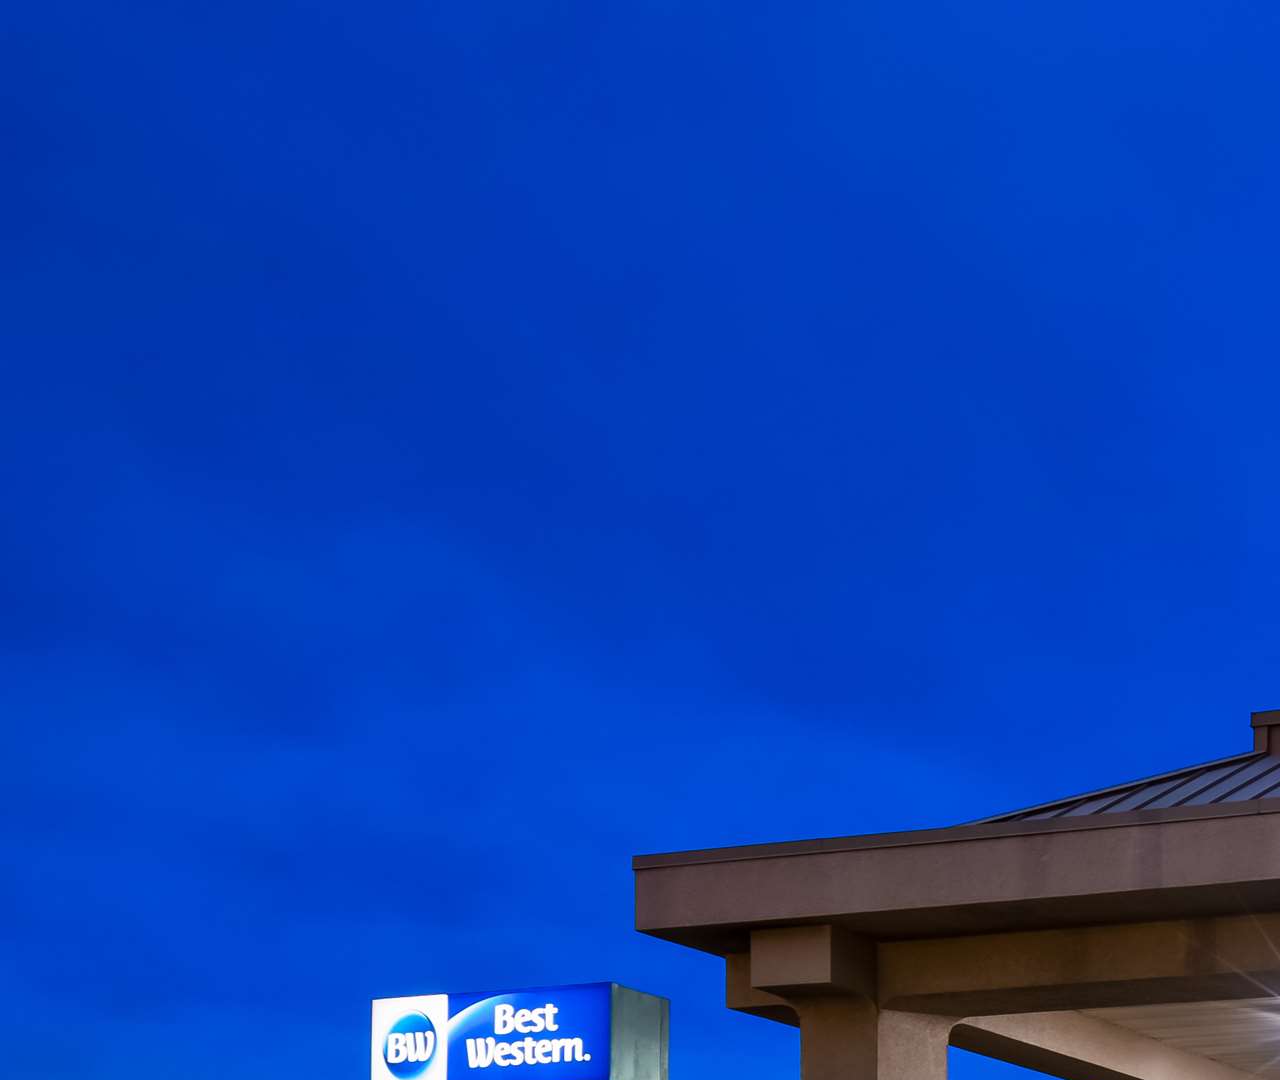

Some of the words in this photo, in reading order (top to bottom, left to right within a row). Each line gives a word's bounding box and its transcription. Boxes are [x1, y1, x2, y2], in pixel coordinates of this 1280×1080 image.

[493, 1003, 559, 1035] Best
[386, 1030, 435, 1065] BW
[465, 1036, 591, 1069] Western.
